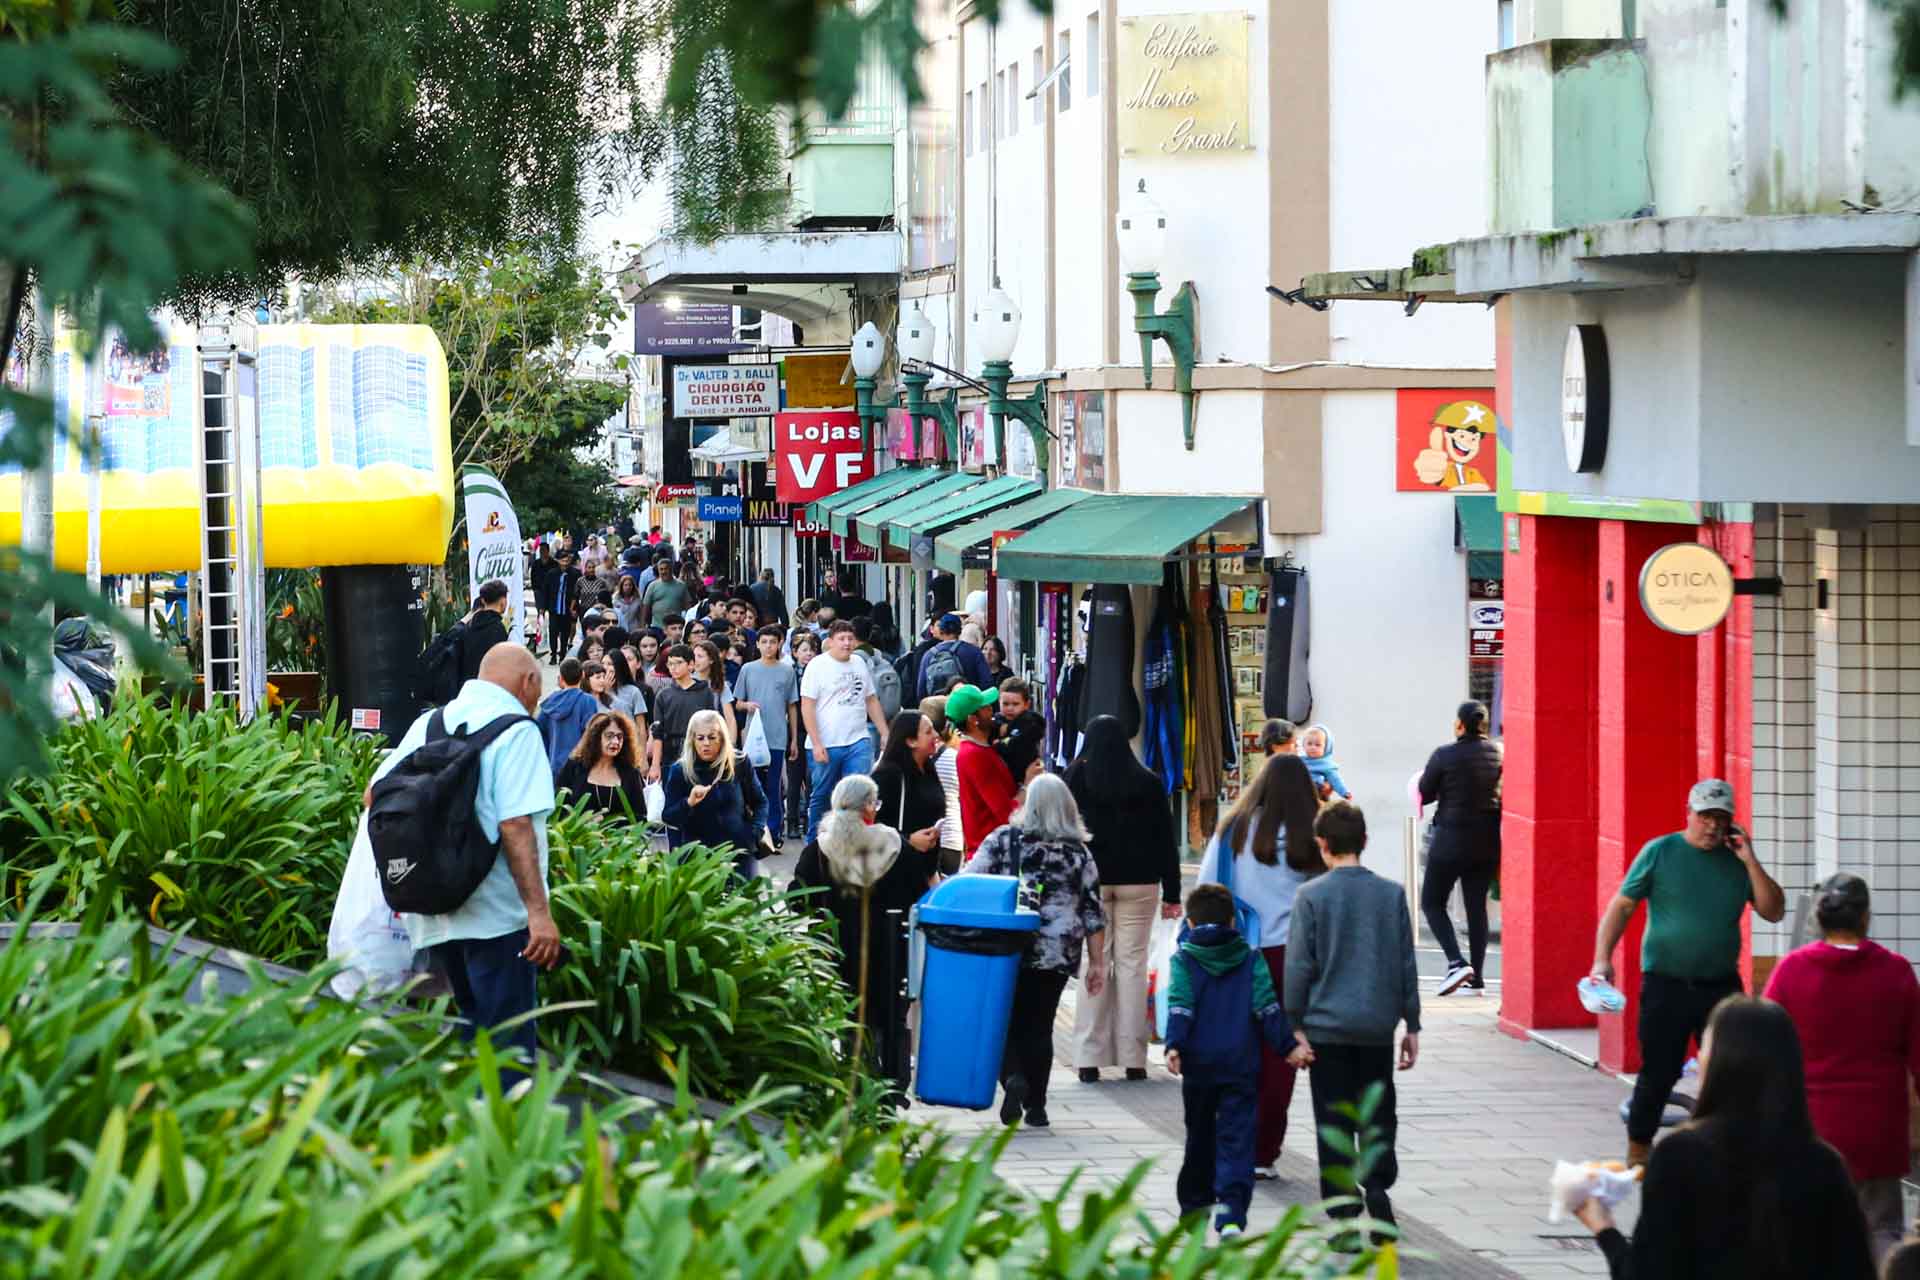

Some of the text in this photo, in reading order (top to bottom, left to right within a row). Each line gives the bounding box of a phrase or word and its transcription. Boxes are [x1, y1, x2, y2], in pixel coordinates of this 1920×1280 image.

[692, 370, 728, 381] VALTER
[745, 369, 774, 379] GALLI
[688, 380, 766, 394] CIRURGIÃO
[692, 394, 762, 405] DENTISTA
[789, 421, 861, 444] Lojas
[750, 501, 788, 520] NALU
[475, 547, 514, 584] Cana
